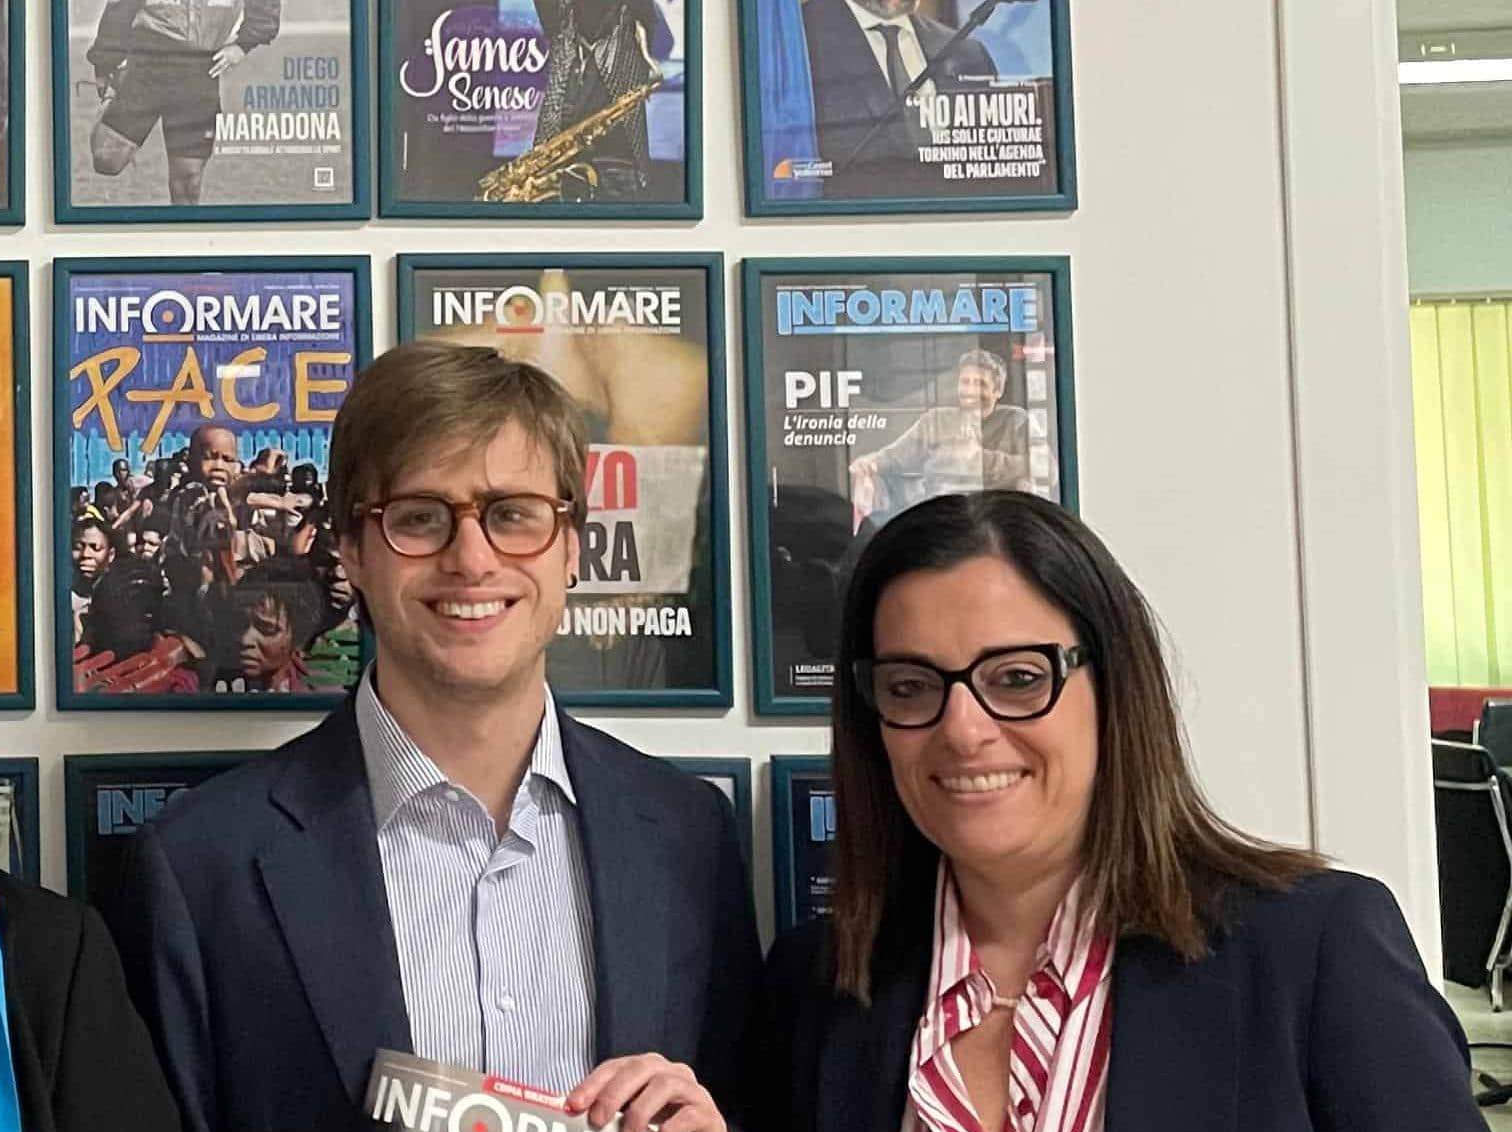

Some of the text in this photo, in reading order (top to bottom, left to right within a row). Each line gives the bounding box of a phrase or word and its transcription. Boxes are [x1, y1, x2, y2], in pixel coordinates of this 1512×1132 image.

[399, 9, 550, 97] James
[283, 56, 339, 81] DIEGO
[243, 84, 340, 109] ARMANDO
[448, 72, 540, 112] Senese
[954, 94, 976, 127] AI
[979, 92, 1043, 127] MURI.
[215, 112, 342, 141] MARADONA
[952, 128, 977, 144] SOLI
[918, 147, 968, 163] TORNINO
[944, 164, 964, 179] DEL
[75, 290, 340, 334] INFORMARE
[433, 285, 681, 326] INFORMARE
[776, 288, 1038, 336] INFORMARE
[785, 371, 863, 409] PIF
[783, 413, 887, 430] L'ironia della
[784, 431, 857, 446] denuncia
[574, 607, 626, 636] NON
[630, 606, 693, 636] PAGA
